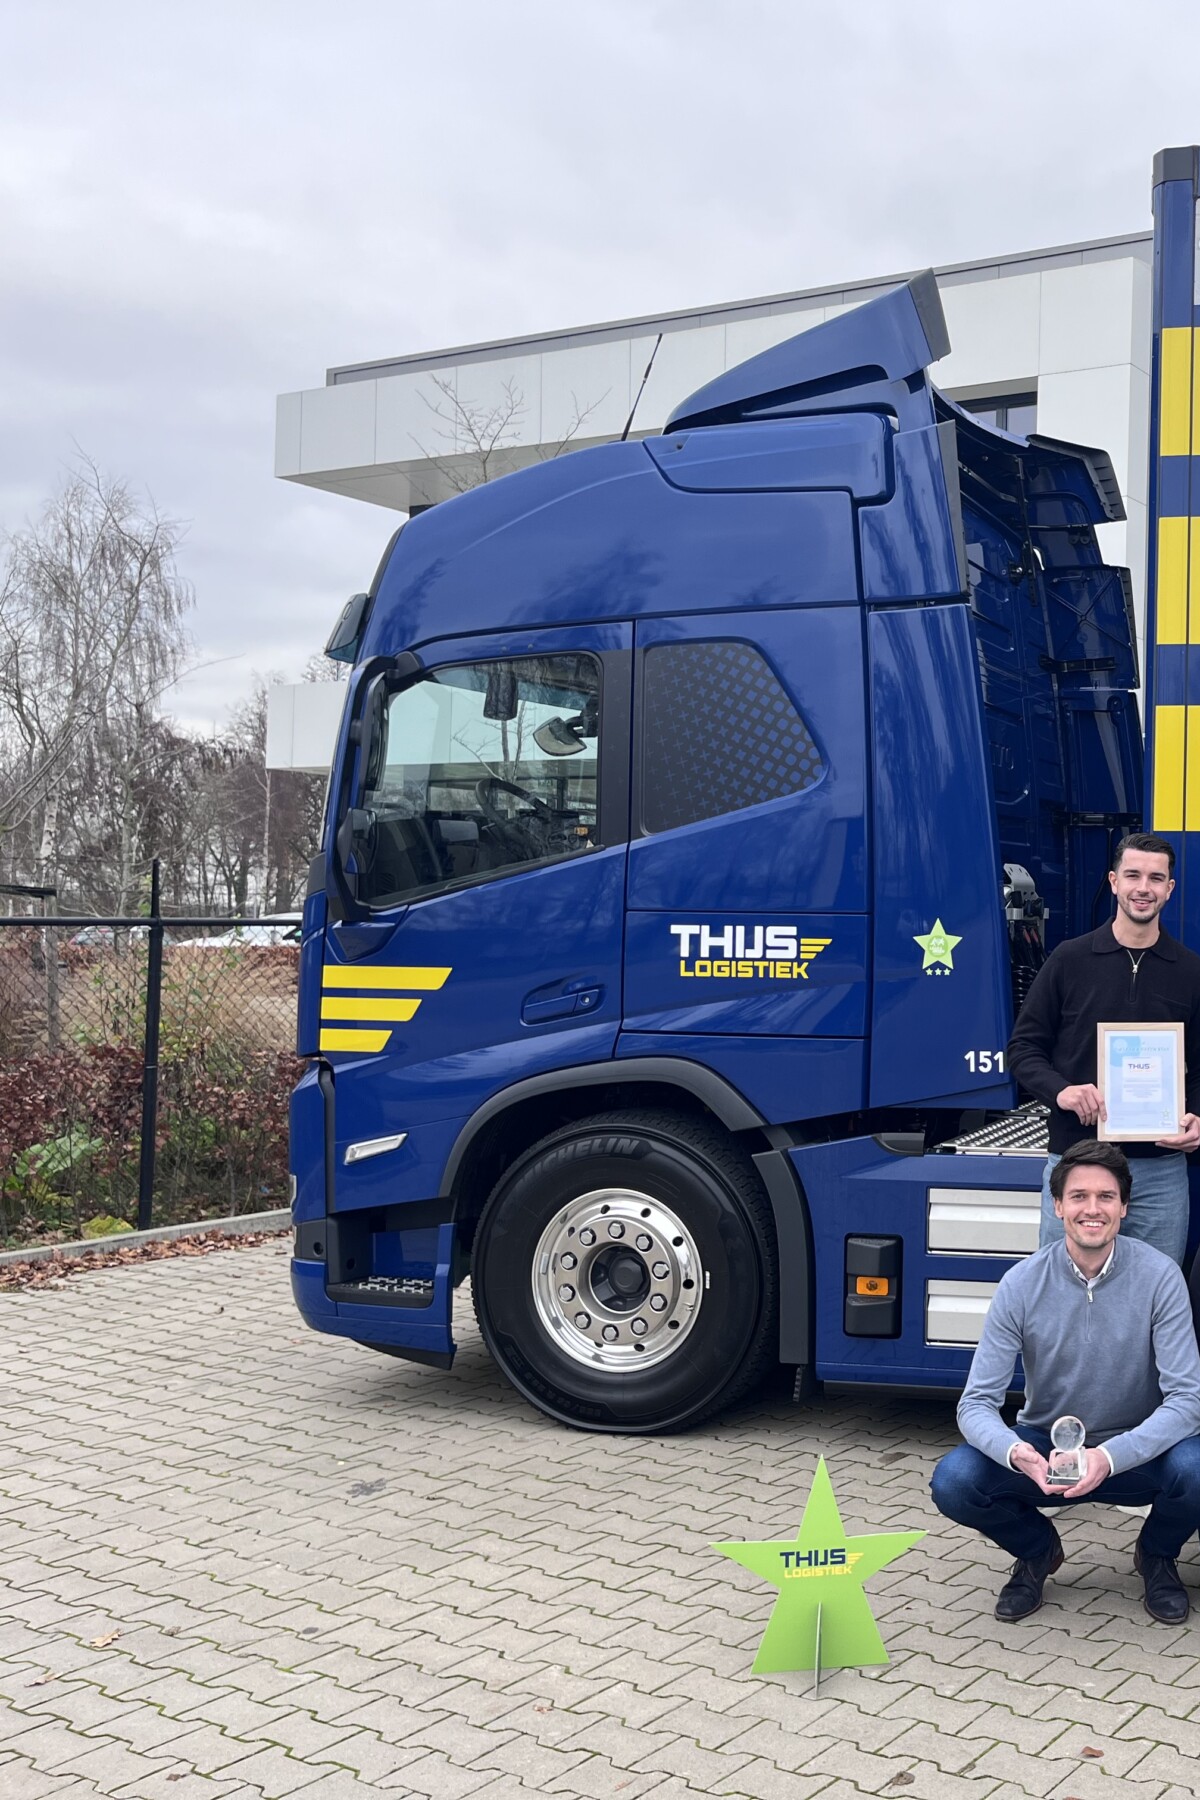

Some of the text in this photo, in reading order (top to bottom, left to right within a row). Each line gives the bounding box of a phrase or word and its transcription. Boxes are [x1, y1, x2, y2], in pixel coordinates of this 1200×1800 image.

[670, 924, 797, 959] THIJS
[680, 959, 809, 979] LOGISTIEK
[964, 1050, 1004, 1073] 151
[779, 1548, 846, 1568] THIJS
[784, 1565, 852, 1579] LOGISTIEK
